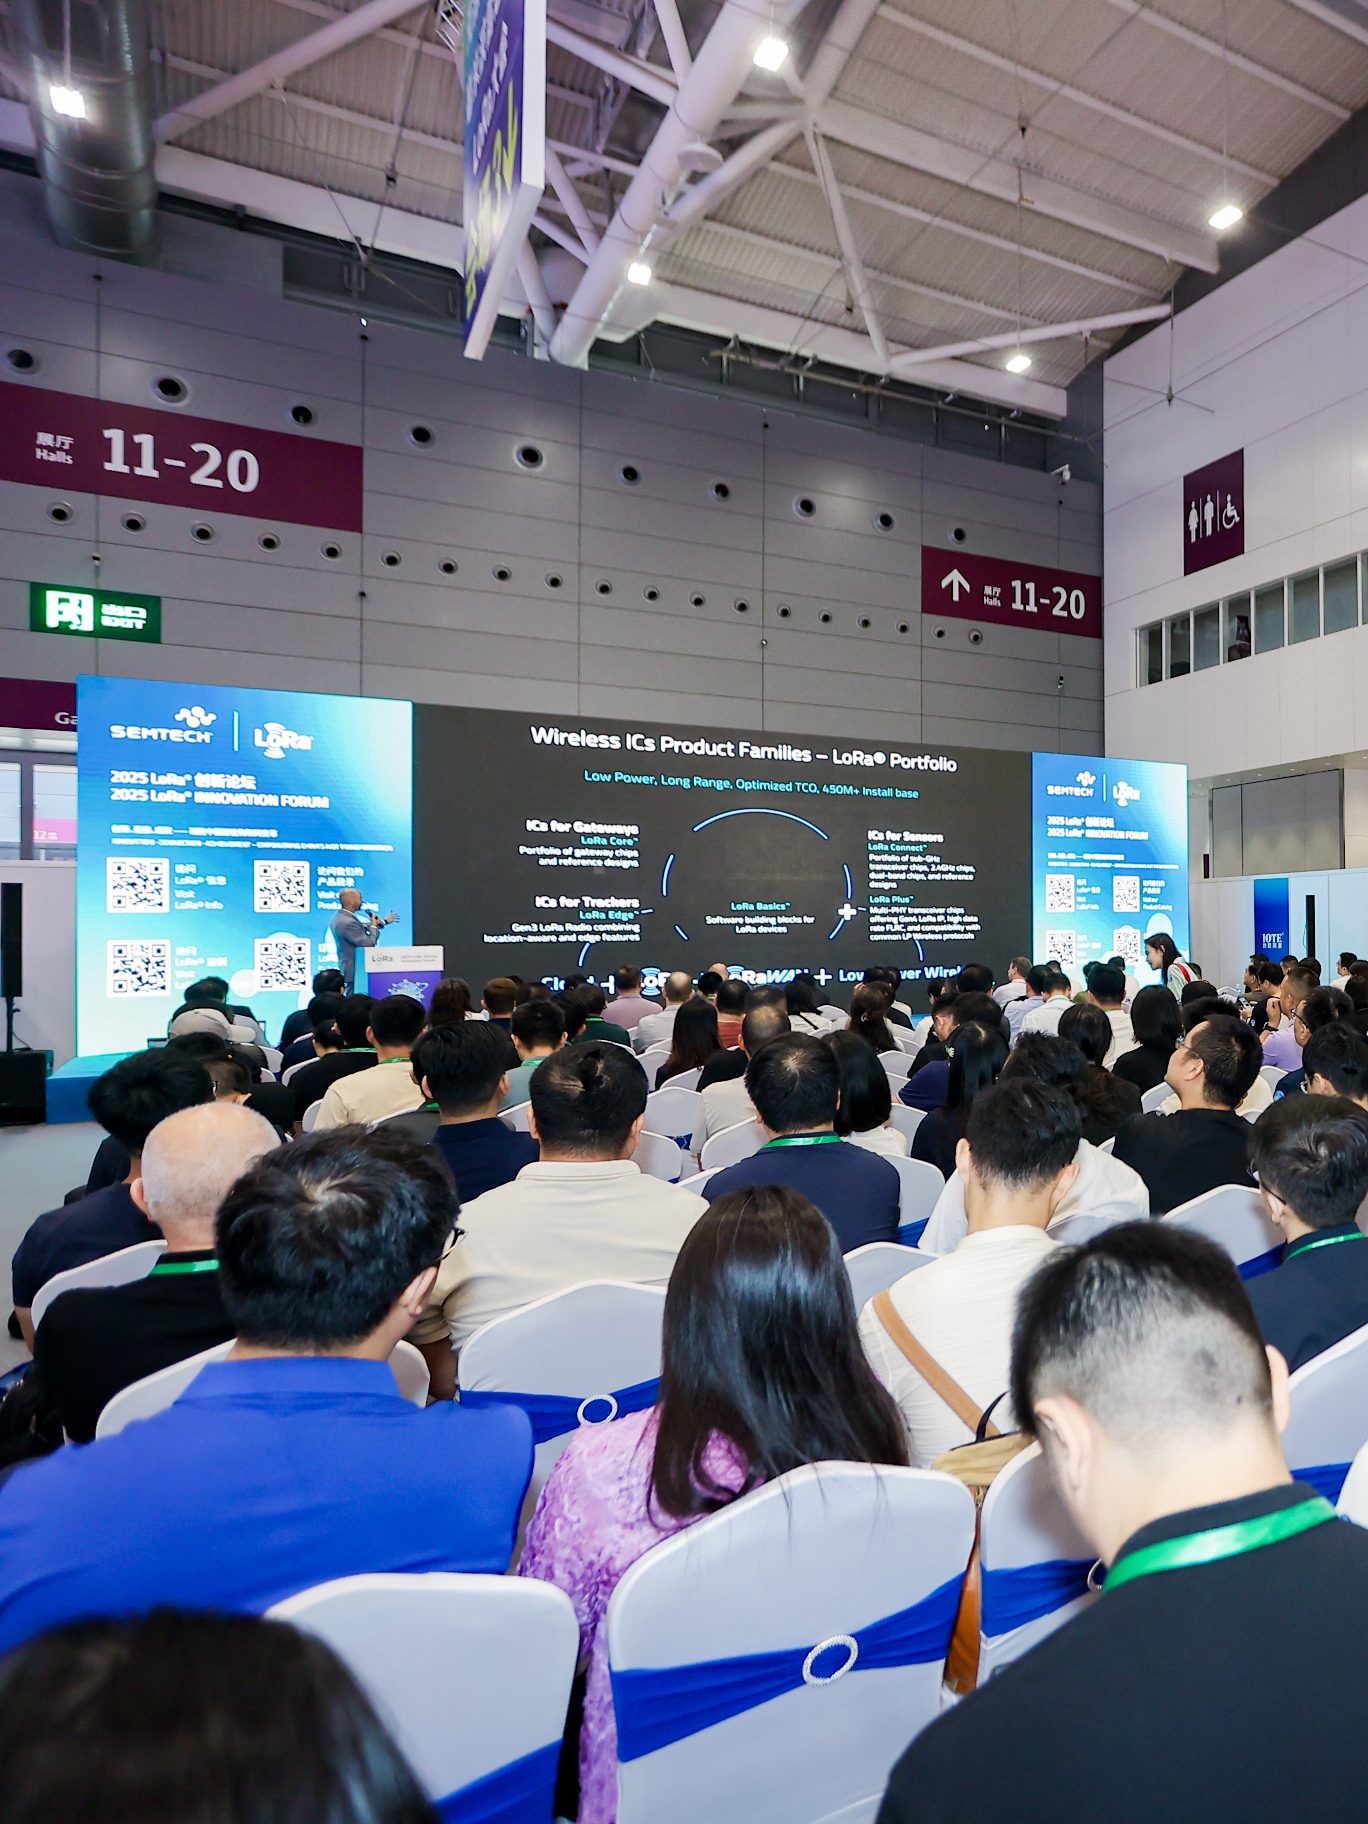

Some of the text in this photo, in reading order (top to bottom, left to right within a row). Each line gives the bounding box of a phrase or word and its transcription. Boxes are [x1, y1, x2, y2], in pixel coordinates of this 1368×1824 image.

[36, 431, 74, 450] 展厅
[35, 448, 74, 465] Halls
[102, 428, 260, 493] 11-20
[984, 596, 1002, 607] Halls
[1011, 579, 1086, 620] 11-20
[101, 616, 147, 630] EXIT
[110, 724, 214, 744] SEMTECH
[530, 726, 621, 750] Wireless
[626, 733, 656, 752] ICs
[660, 736, 735, 757] Product
[738, 742, 812, 763] Families
[889, 752, 958, 772] Portfolio
[110, 770, 149, 785] 2025
[584, 770, 919, 799] Low Power, Long Range, Optimized TCO, 450M+ Install base
[110, 788, 149, 802] 2025
[194, 791, 279, 807] INNOVATION
[280, 794, 330, 809] FORUM
[526, 819, 640, 836] ICs for Gateways
[580, 836, 608, 845] LoRa
[886, 830, 902, 841] for
[902, 831, 944, 842] Sensors
[519, 846, 639, 858] Portfolio of gateway chips
[868, 842, 889, 851] LoRa
[538, 857, 640, 869] and reference designs
[868, 854, 900, 862] Portfolio
[900, 854, 910, 862] of
[927, 872, 941, 880] and
[535, 896, 640, 908] ICs for Trackers
[730, 902, 755, 910] LoRa
[870, 896, 890, 904] LoRa
[580, 910, 606, 920] LoRa
[705, 916, 816, 925] Software building blocks for
[512, 923, 640, 933] Gen3 LoRa Radio combining
[736, 925, 788, 934] LoRa devices
[906, 924, 920, 932] and
[484, 933, 640, 944] location-aware and edge features
[942, 932, 975, 941] protocols
